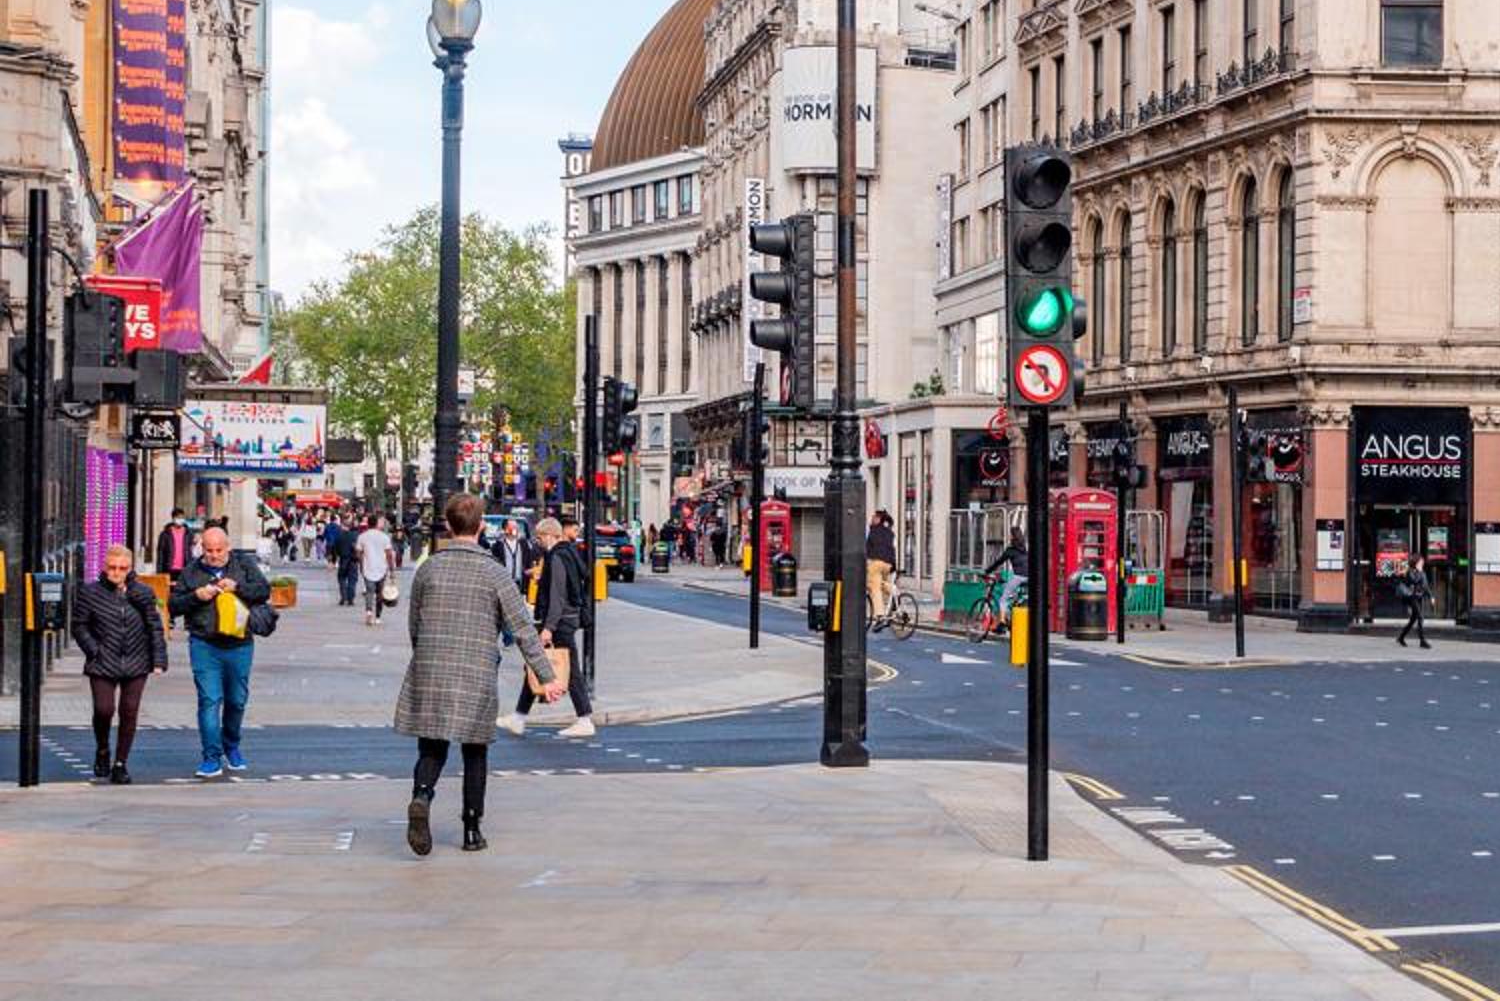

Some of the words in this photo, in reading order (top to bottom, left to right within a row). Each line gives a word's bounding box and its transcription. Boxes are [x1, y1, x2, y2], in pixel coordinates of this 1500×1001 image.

[784, 103, 871, 122] MORMN
[1361, 434, 1461, 460] ANGUS
[1361, 464, 1461, 478] STEAKHOUSE
